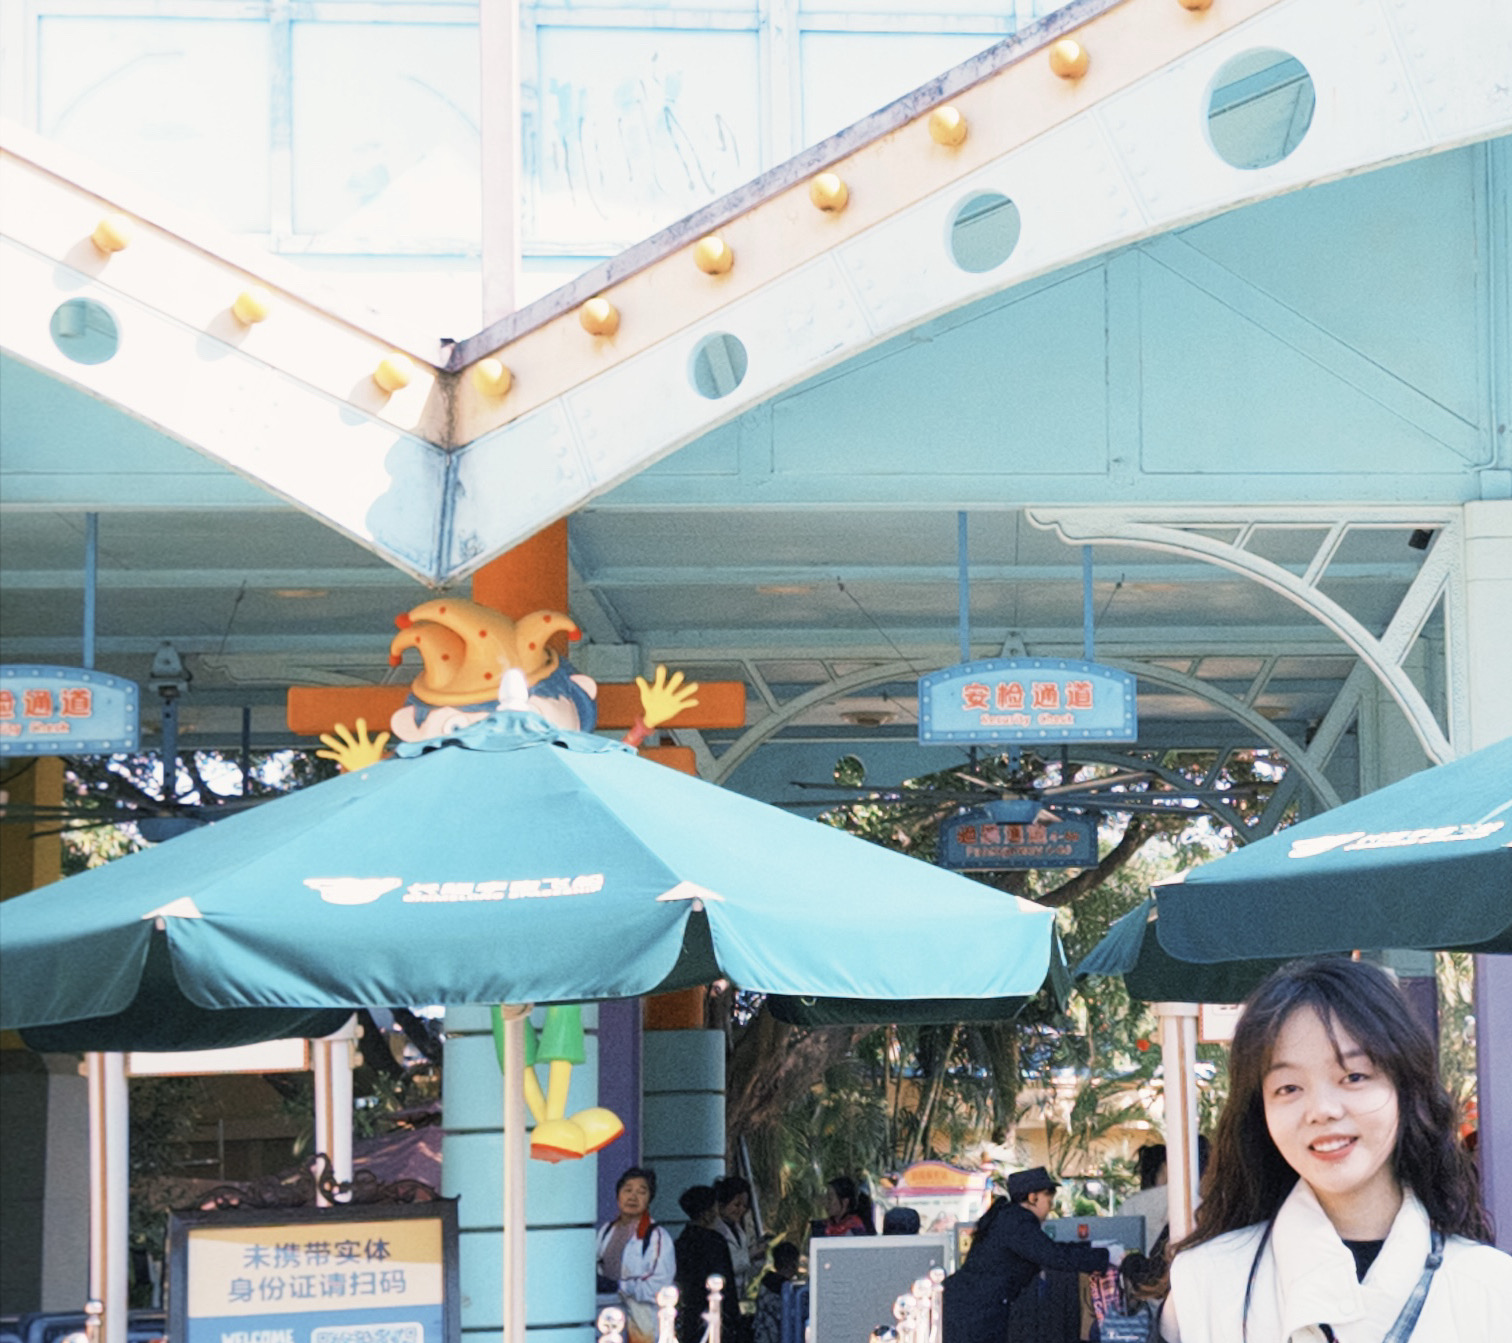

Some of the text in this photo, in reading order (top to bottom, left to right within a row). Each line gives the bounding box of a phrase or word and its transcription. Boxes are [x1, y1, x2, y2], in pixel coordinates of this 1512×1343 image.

[961, 680, 1095, 710] 安检通道
[242, 1235, 392, 1270] 未携带实体
[228, 1268, 407, 1304] 身份证请扫码
